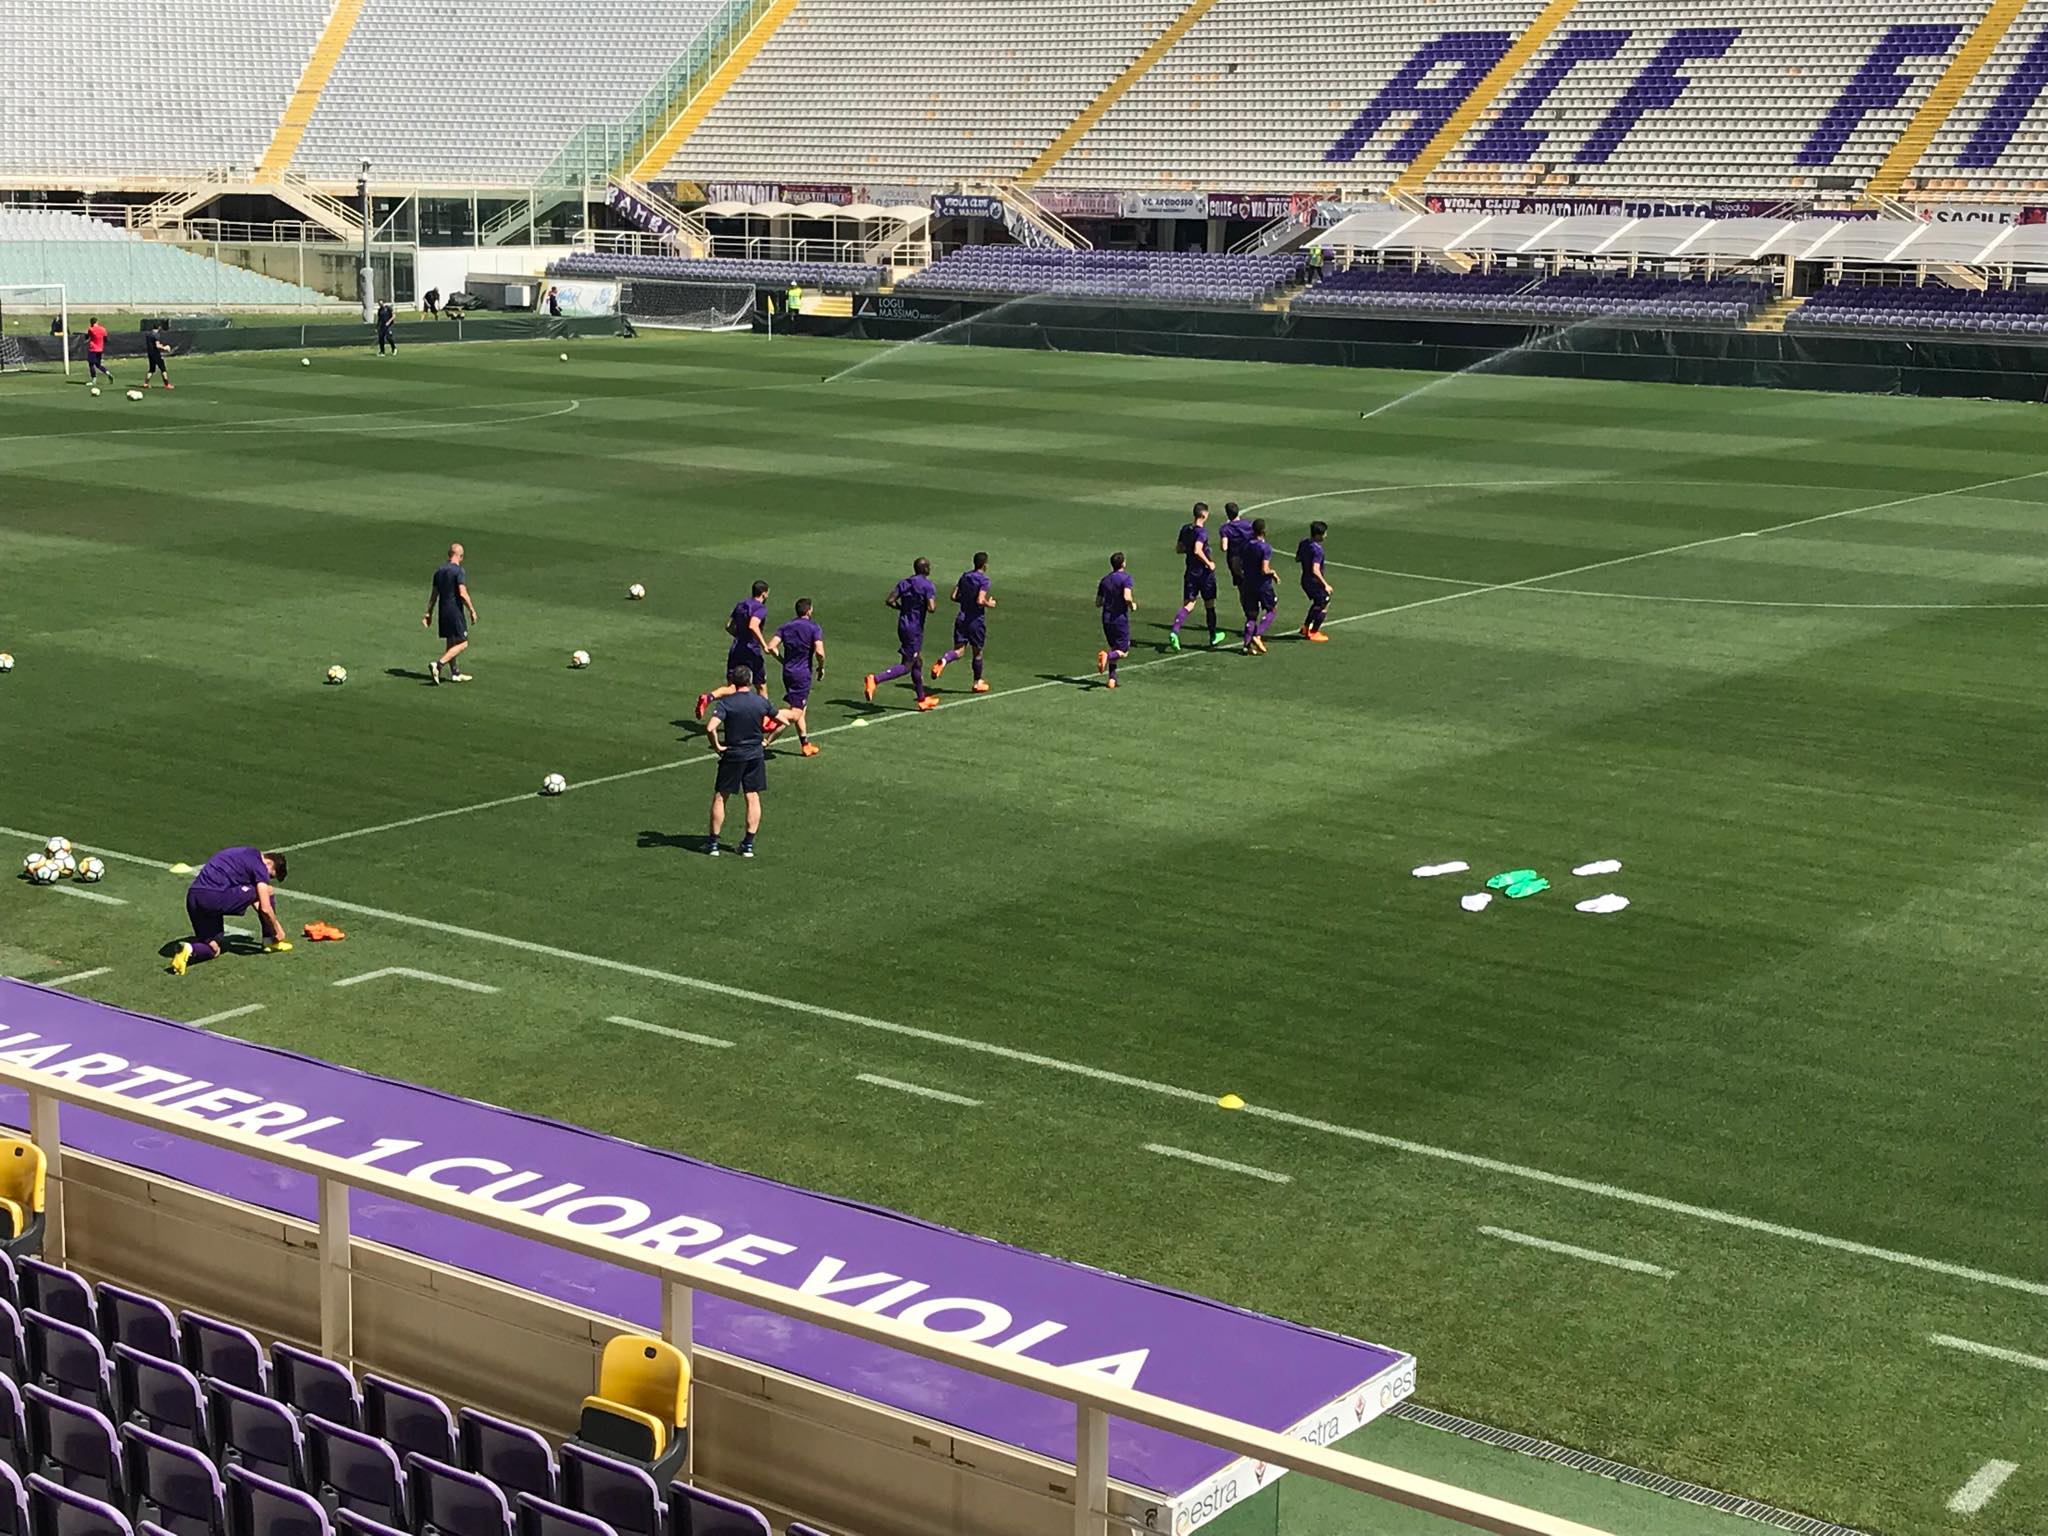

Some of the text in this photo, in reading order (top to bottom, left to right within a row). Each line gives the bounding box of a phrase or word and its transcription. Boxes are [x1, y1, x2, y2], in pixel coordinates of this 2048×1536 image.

[1322, 28, 1742, 166] ACF
[1209, 201, 1232, 217] COLLE
[1444, 198, 1521, 208] VIOLA CLUB
[1535, 203, 1607, 217] PRATO VIOLA
[1624, 203, 1713, 219] TRENTO
[879, 309, 920, 319] MASSIMO
[405, 1157, 799, 1275] CUORE
[798, 1255, 1151, 1390] VIOLA
[1190, 1479, 1238, 1525] estra
